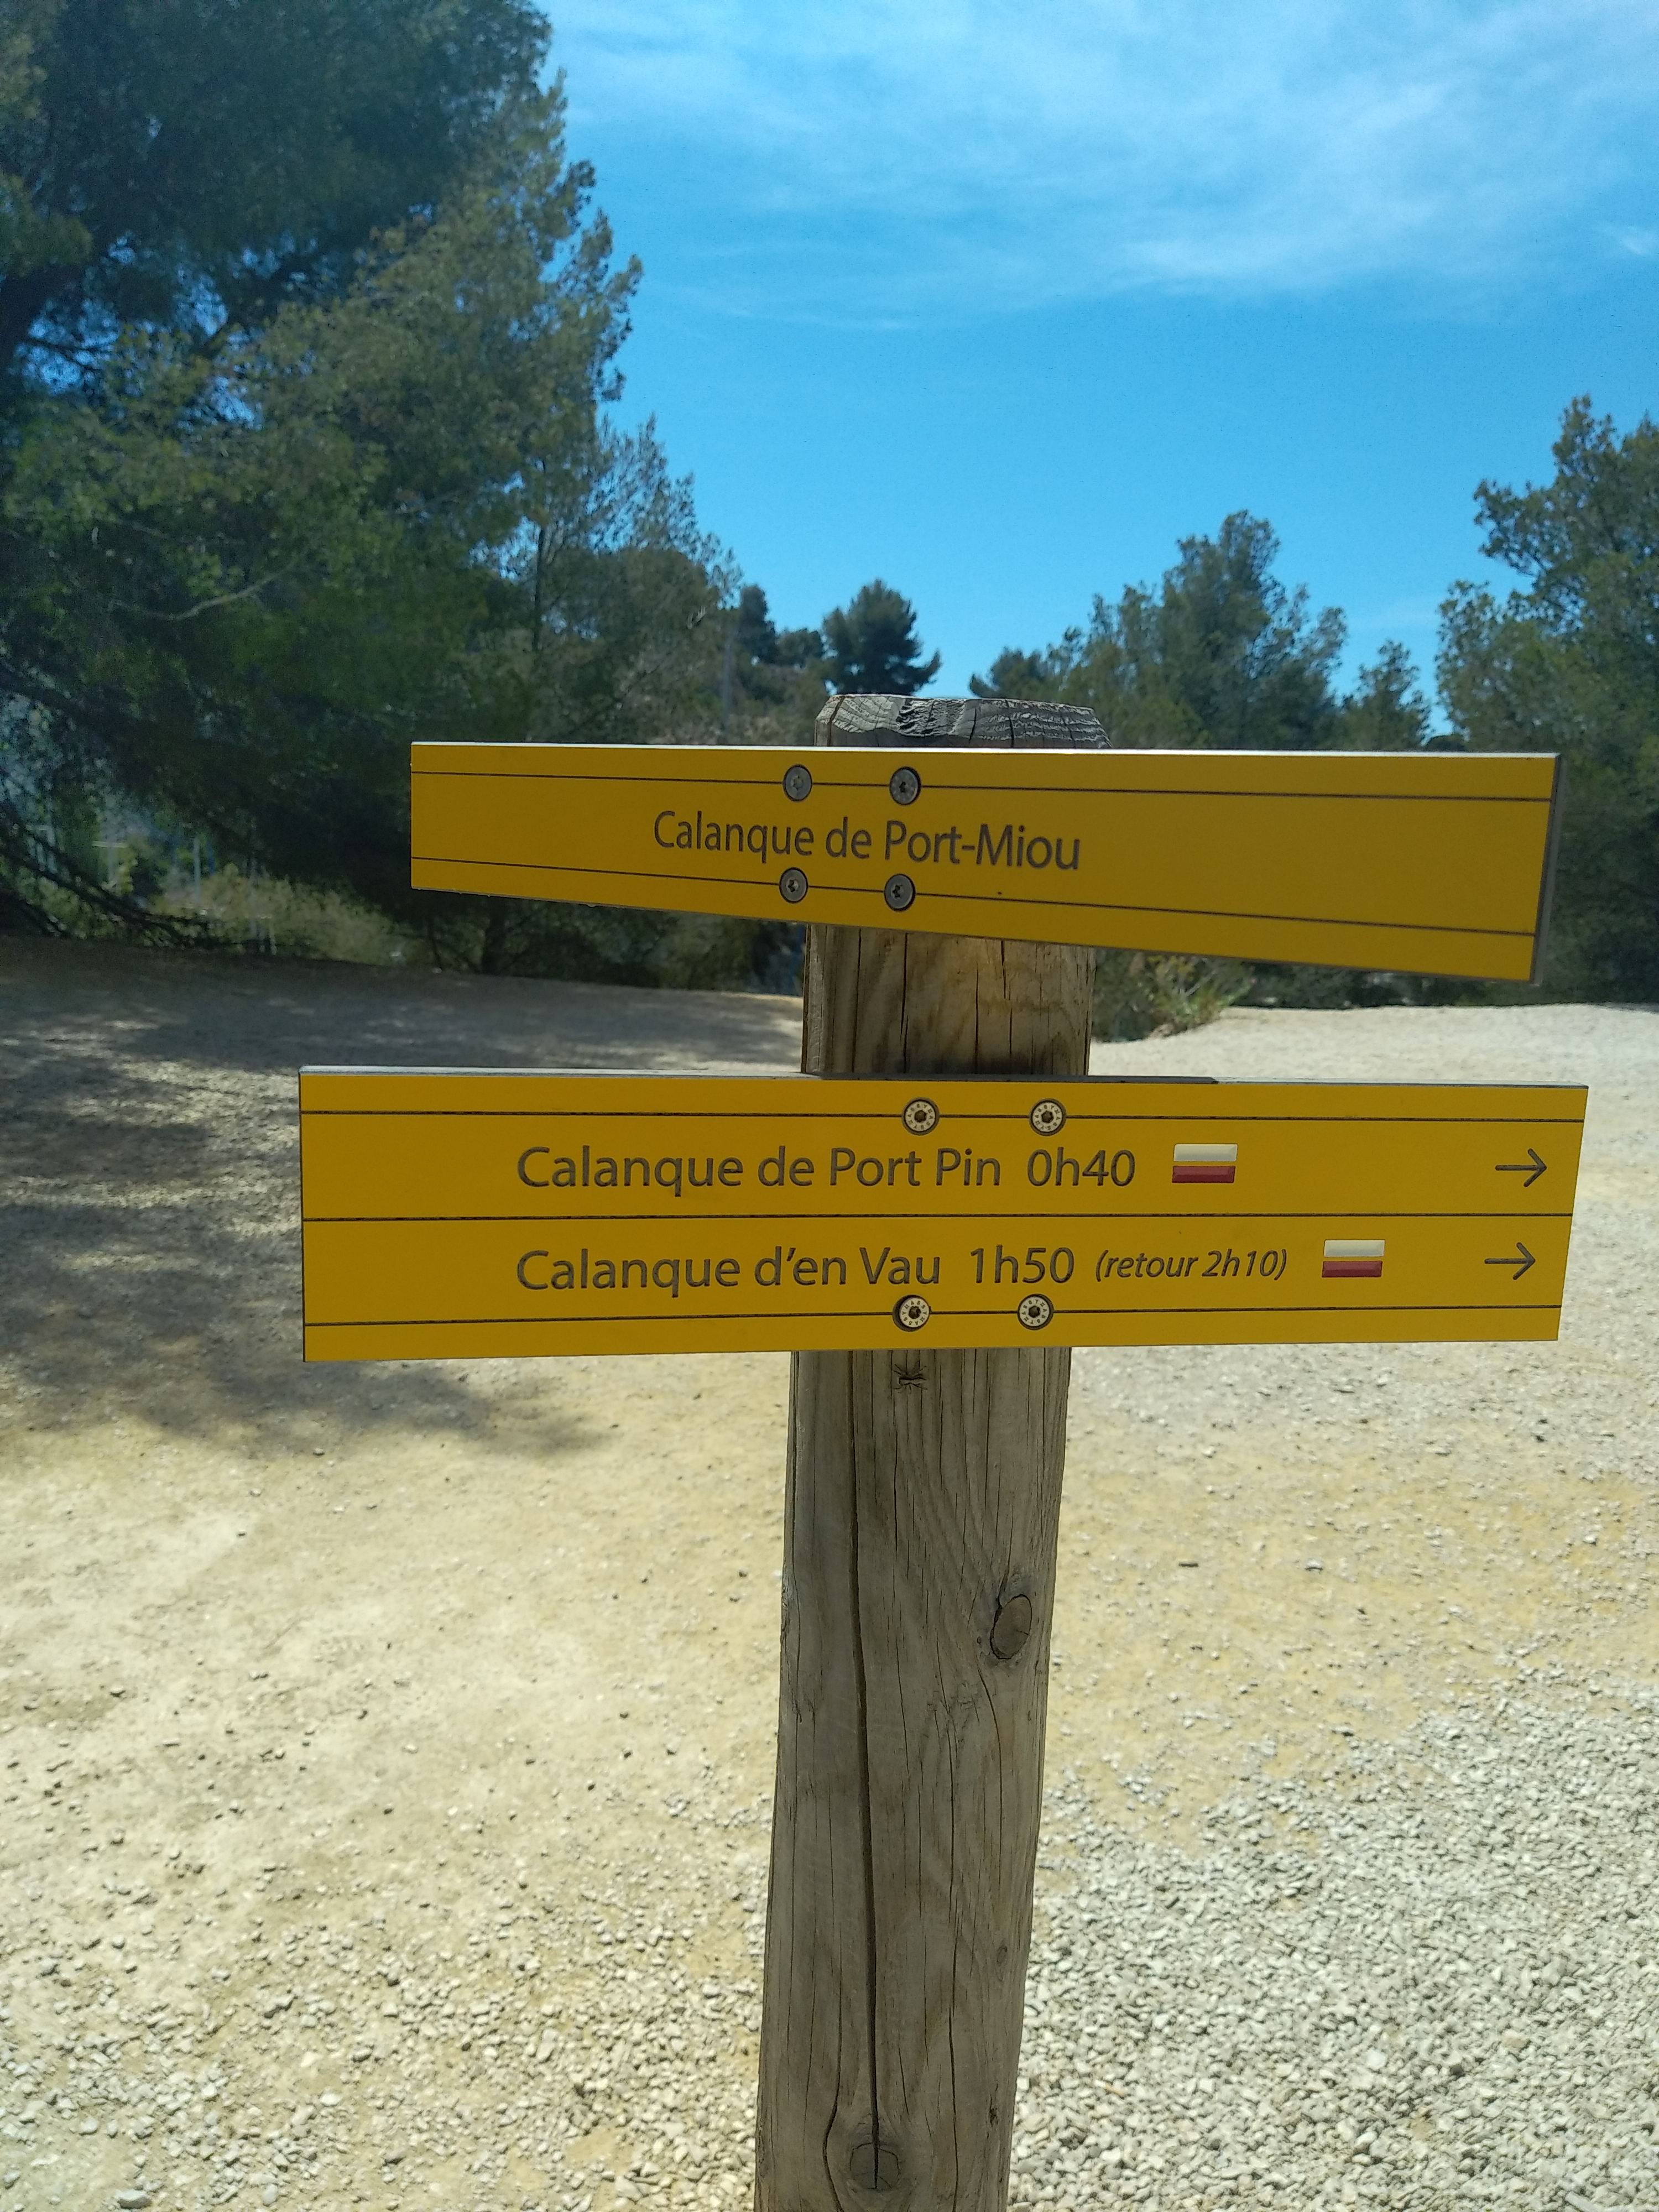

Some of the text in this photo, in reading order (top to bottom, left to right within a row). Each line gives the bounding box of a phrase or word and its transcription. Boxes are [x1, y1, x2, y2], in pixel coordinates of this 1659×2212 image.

[654, 810, 1080, 870] Calanque de Port-Miou
[517, 1145, 1135, 1197] Calanque de Port Pin 0h40
[517, 1248, 740, 1298] Calanque
[859, 1247, 940, 1285] Vau
[970, 1244, 1074, 1284] 1h50
[1095, 1250, 1199, 1282] (retour
[1201, 1249, 1287, 1281] 2h10)
